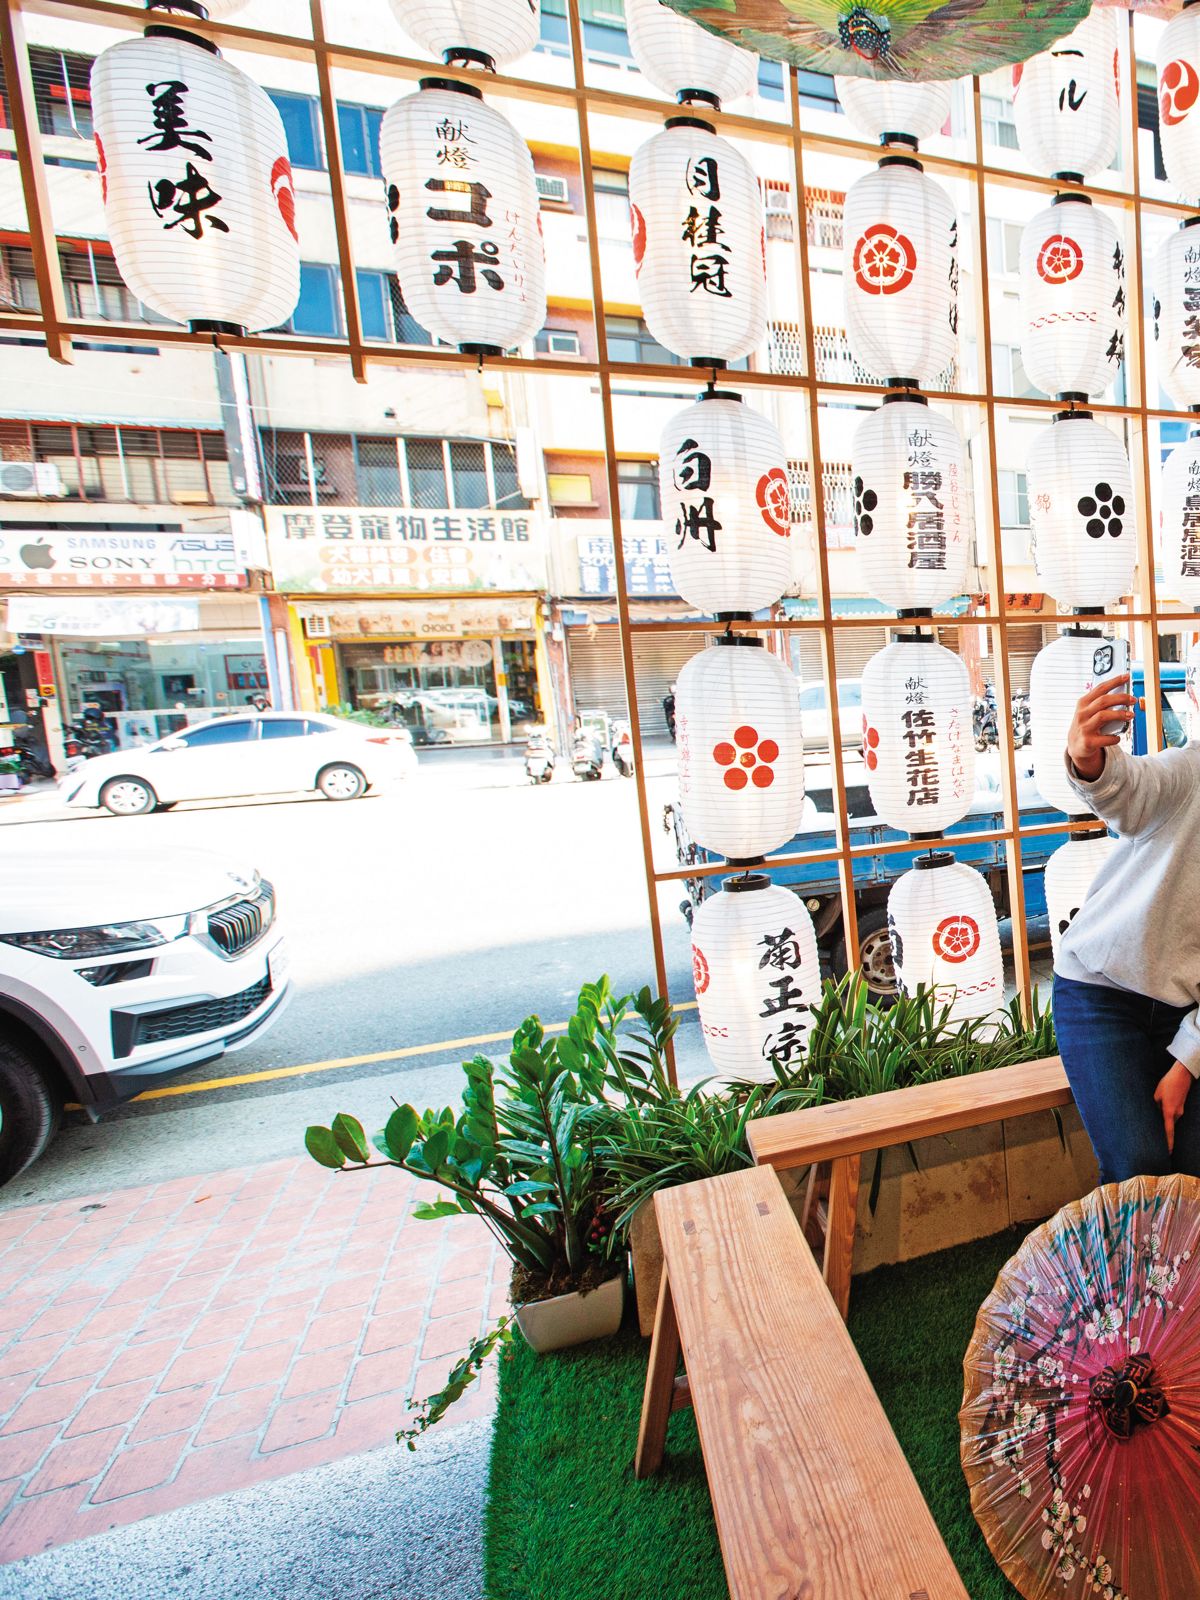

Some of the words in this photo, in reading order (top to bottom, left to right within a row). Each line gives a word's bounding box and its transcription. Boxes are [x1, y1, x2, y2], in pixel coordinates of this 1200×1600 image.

[137, 80, 230, 240] 美味
[424, 178, 505, 294] コポ
[681, 157, 733, 298] 月桂冠
[66, 537, 157, 550] SAMSUNG
[283, 514, 530, 542] 摩登寵物生活館
[69, 556, 158, 569] SONY
[421, 623, 455, 634] CHOICE
[901, 709, 939, 806] 佐竹生花店
